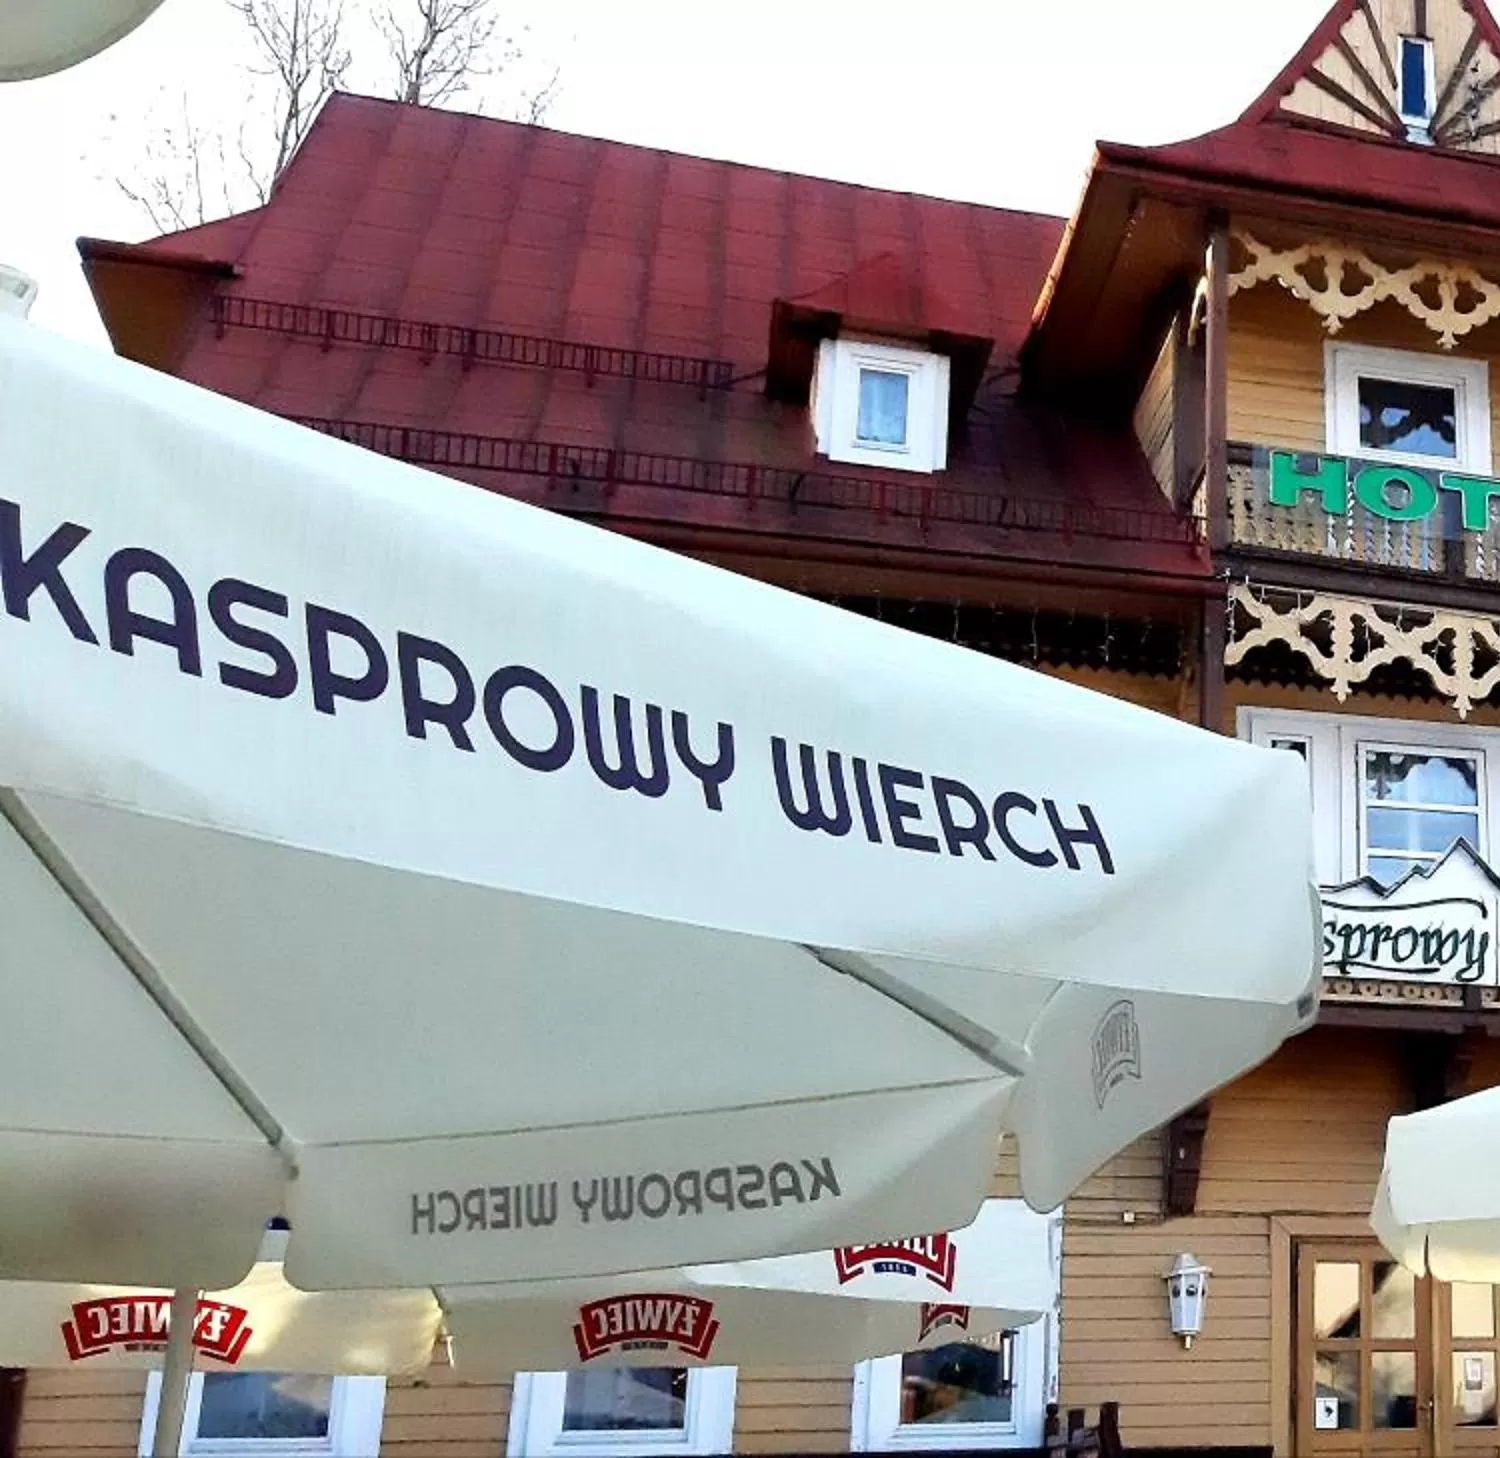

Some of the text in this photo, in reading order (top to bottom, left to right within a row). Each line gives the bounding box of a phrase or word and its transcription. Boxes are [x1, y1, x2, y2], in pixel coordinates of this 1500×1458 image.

[0, 498, 1115, 875] KASPROWY WIERCH
[1323, 917, 1489, 982] sprowy
